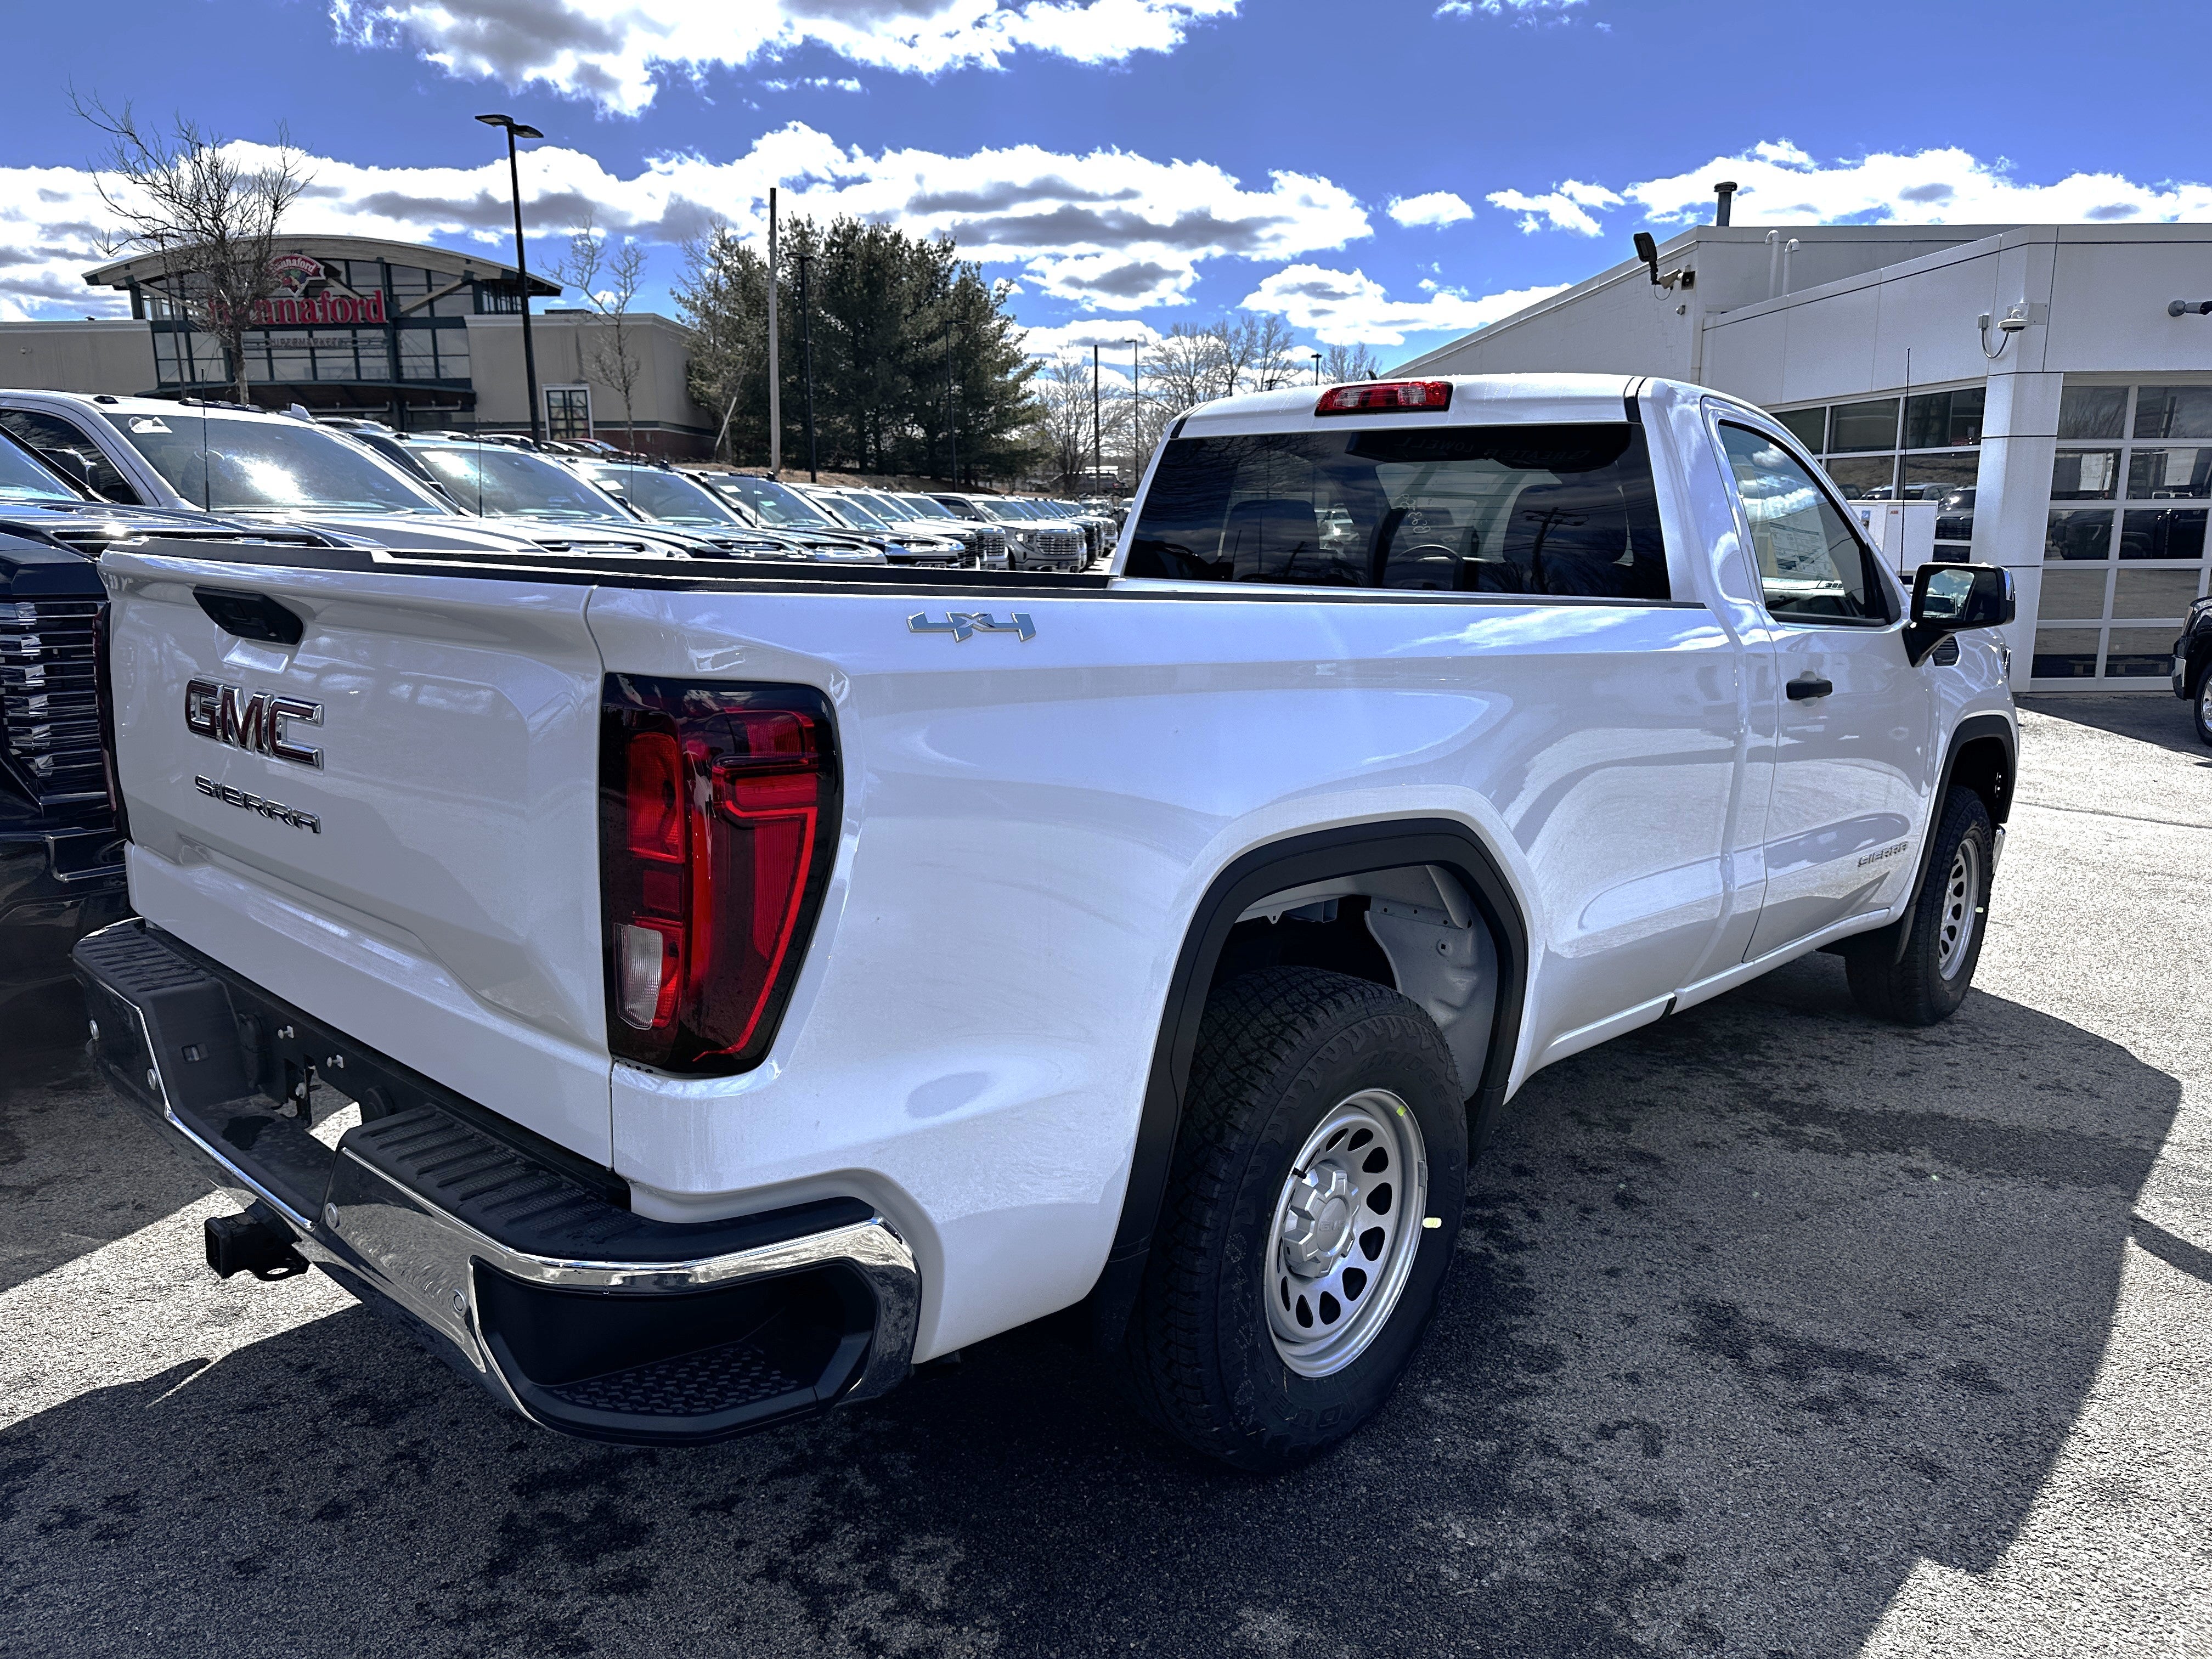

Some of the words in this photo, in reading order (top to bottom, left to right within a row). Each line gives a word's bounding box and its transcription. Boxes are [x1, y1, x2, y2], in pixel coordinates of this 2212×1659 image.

[185, 677, 325, 769] GMC
[195, 774, 321, 834] SIERRA
[1857, 840, 1909, 867] SIERRA
